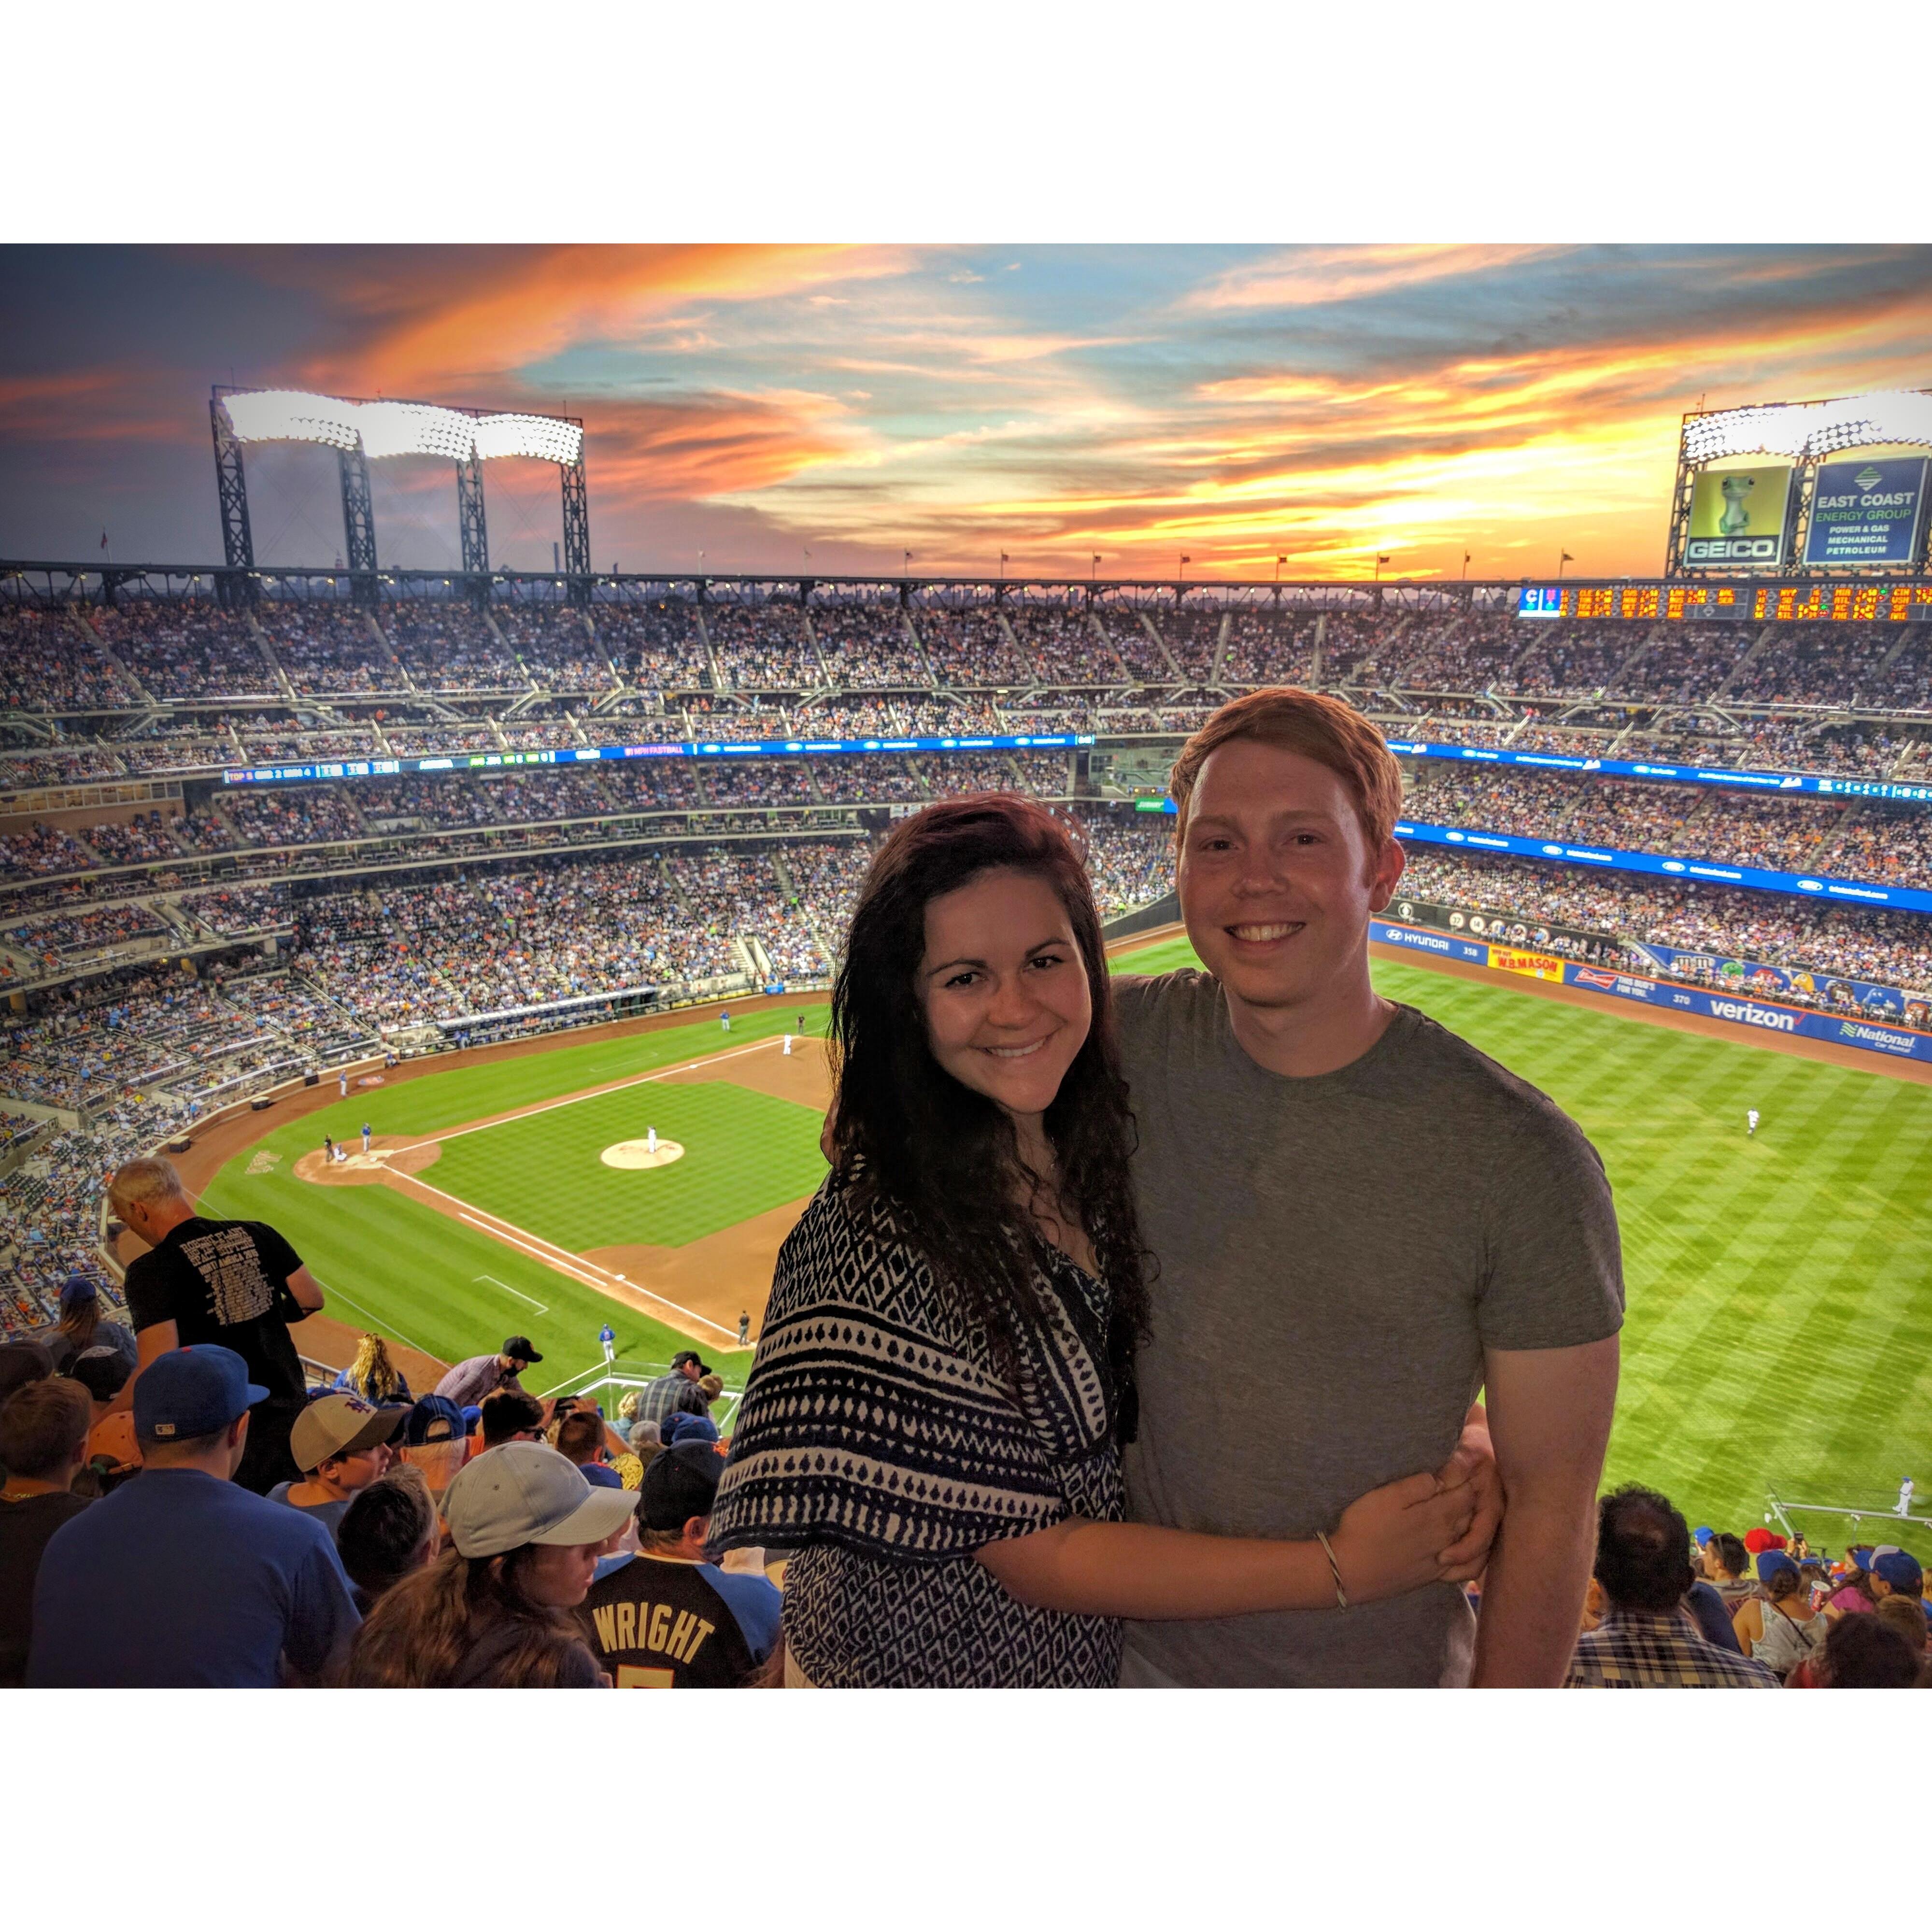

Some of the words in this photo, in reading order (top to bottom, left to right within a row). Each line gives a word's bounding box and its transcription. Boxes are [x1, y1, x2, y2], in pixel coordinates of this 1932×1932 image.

[1817, 495, 1857, 509] EAST
[1860, 492, 1915, 507] COAST
[1816, 510, 1863, 522] ENERGY
[1866, 509, 1911, 520] GROUP
[1829, 526, 1861, 534] POWER
[1862, 525, 1870, 533] &
[1871, 524, 1889, 533] GAS
[1828, 535, 1888, 544] MECHANICAL
[1689, 539, 1775, 559] GEICO
[1826, 546, 1887, 555] PETROLEUM
[229, 772, 244, 781] TOP
[1404, 933, 1449, 951] HYUNDAI
[1463, 946, 1478, 957] 358
[1673, 994, 1690, 1005] 370
[1710, 999, 1794, 1031] verizon
[1856, 1026, 1916, 1048] National
[1875, 1041, 1888, 1051] Car
[1889, 1043, 1911, 1053] Rental
[592, 1602, 715, 1664] WRIGHT
